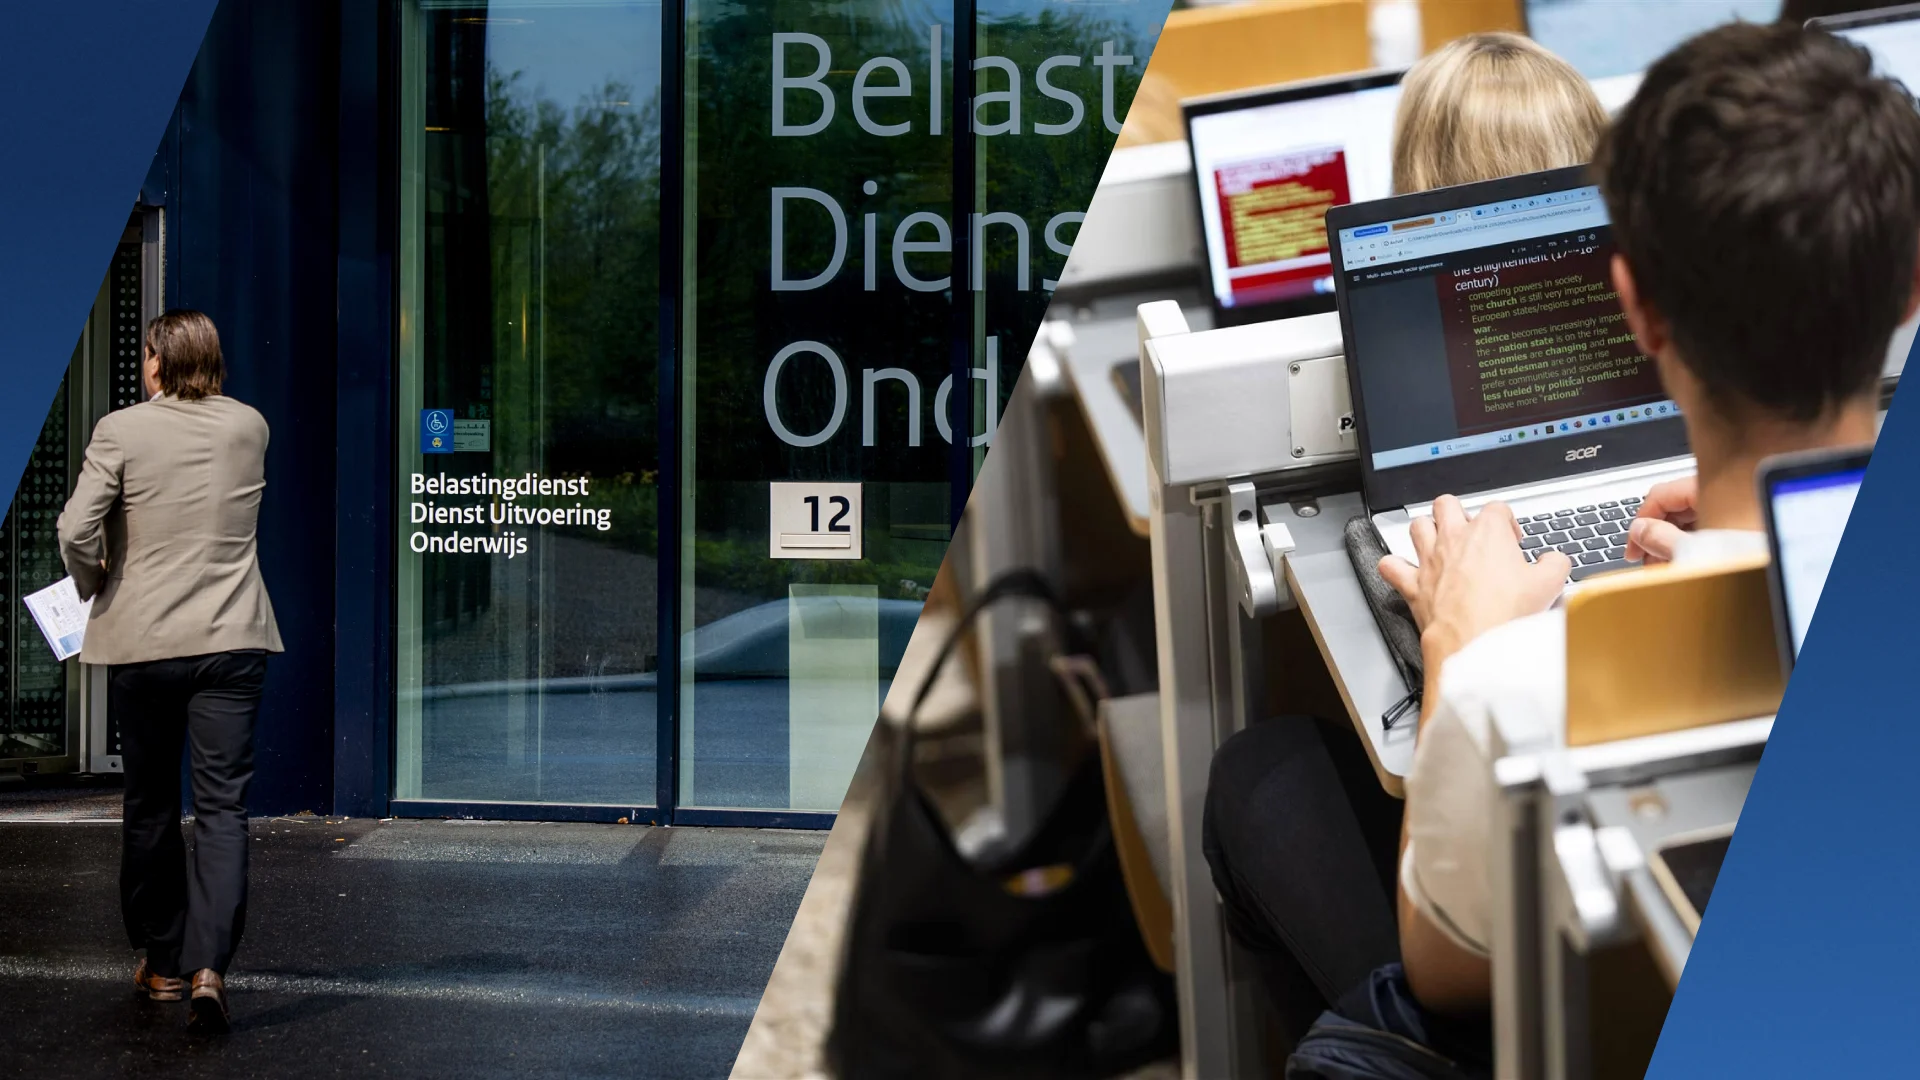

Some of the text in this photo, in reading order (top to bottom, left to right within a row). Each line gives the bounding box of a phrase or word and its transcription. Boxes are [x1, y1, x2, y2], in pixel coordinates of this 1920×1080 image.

[771, 23, 1161, 137] Belast
[771, 181, 1089, 292] Diens
[1455, 274, 1499, 291] century)
[1468, 275, 1583, 301] competing powers in society
[1470, 282, 1604, 312] the church is still very important
[1471, 310, 1511, 324] European
[1513, 299, 1570, 317] states/regions
[1571, 297, 1585, 306] are
[1475, 334, 1510, 346] science
[1511, 327, 1548, 339] becomes
[1549, 317, 1597, 332] increasingly
[1476, 348, 1490, 357] the
[1498, 342, 1528, 353] nation
[1530, 336, 1554, 347] state
[1556, 334, 1563, 342] is
[1564, 333, 1576, 342] on
[1577, 330, 1591, 338] the
[1593, 327, 1608, 336] rise
[1478, 353, 1528, 368] economies
[1530, 350, 1543, 359] are
[1545, 342, 1587, 356] changing
[1589, 339, 1605, 348] and
[1480, 350, 1610, 379] and tradesman are on the rise
[1481, 354, 1648, 391] prefer communities and societies that are
[1483, 366, 1639, 401] less fueled by political conflict and
[763, 335, 998, 447] Ond
[1484, 400, 1515, 412] behave
[1516, 397, 1538, 407] more
[1565, 445, 1602, 462] acer
[411, 472, 589, 500] Belastingdienst
[411, 502, 612, 531] Dienst Uitvoering
[803, 496, 851, 532] 12
[410, 531, 528, 559] Onderwijs
